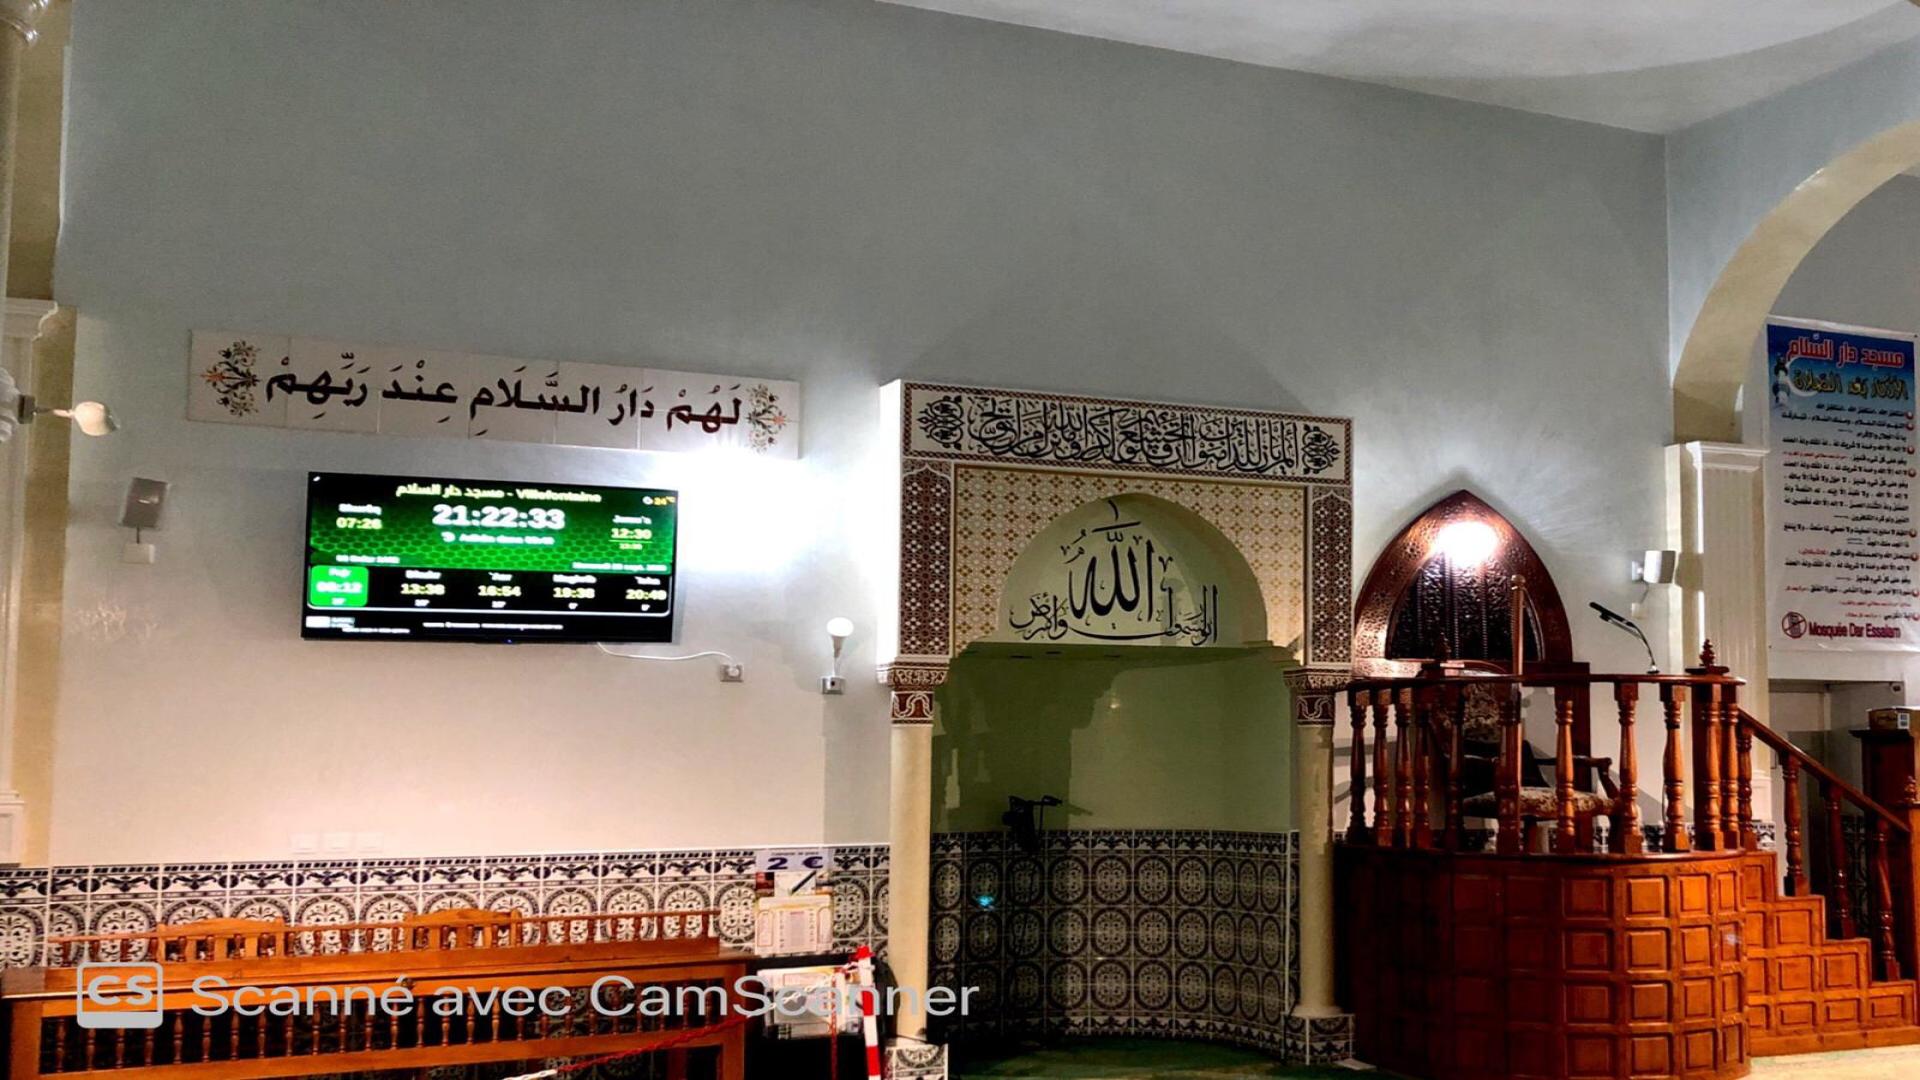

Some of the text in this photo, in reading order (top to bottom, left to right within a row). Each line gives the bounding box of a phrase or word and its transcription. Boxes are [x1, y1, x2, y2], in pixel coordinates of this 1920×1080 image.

[515, 488, 601, 503] Villefontaine
[336, 517, 383, 530] 07:26
[432, 504, 566, 531] 21:22:33
[611, 528, 653, 541] 12:30
[1809, 621, 1901, 639] Mosquée Dar Essalam
[767, 856, 824, 871] 2 €
